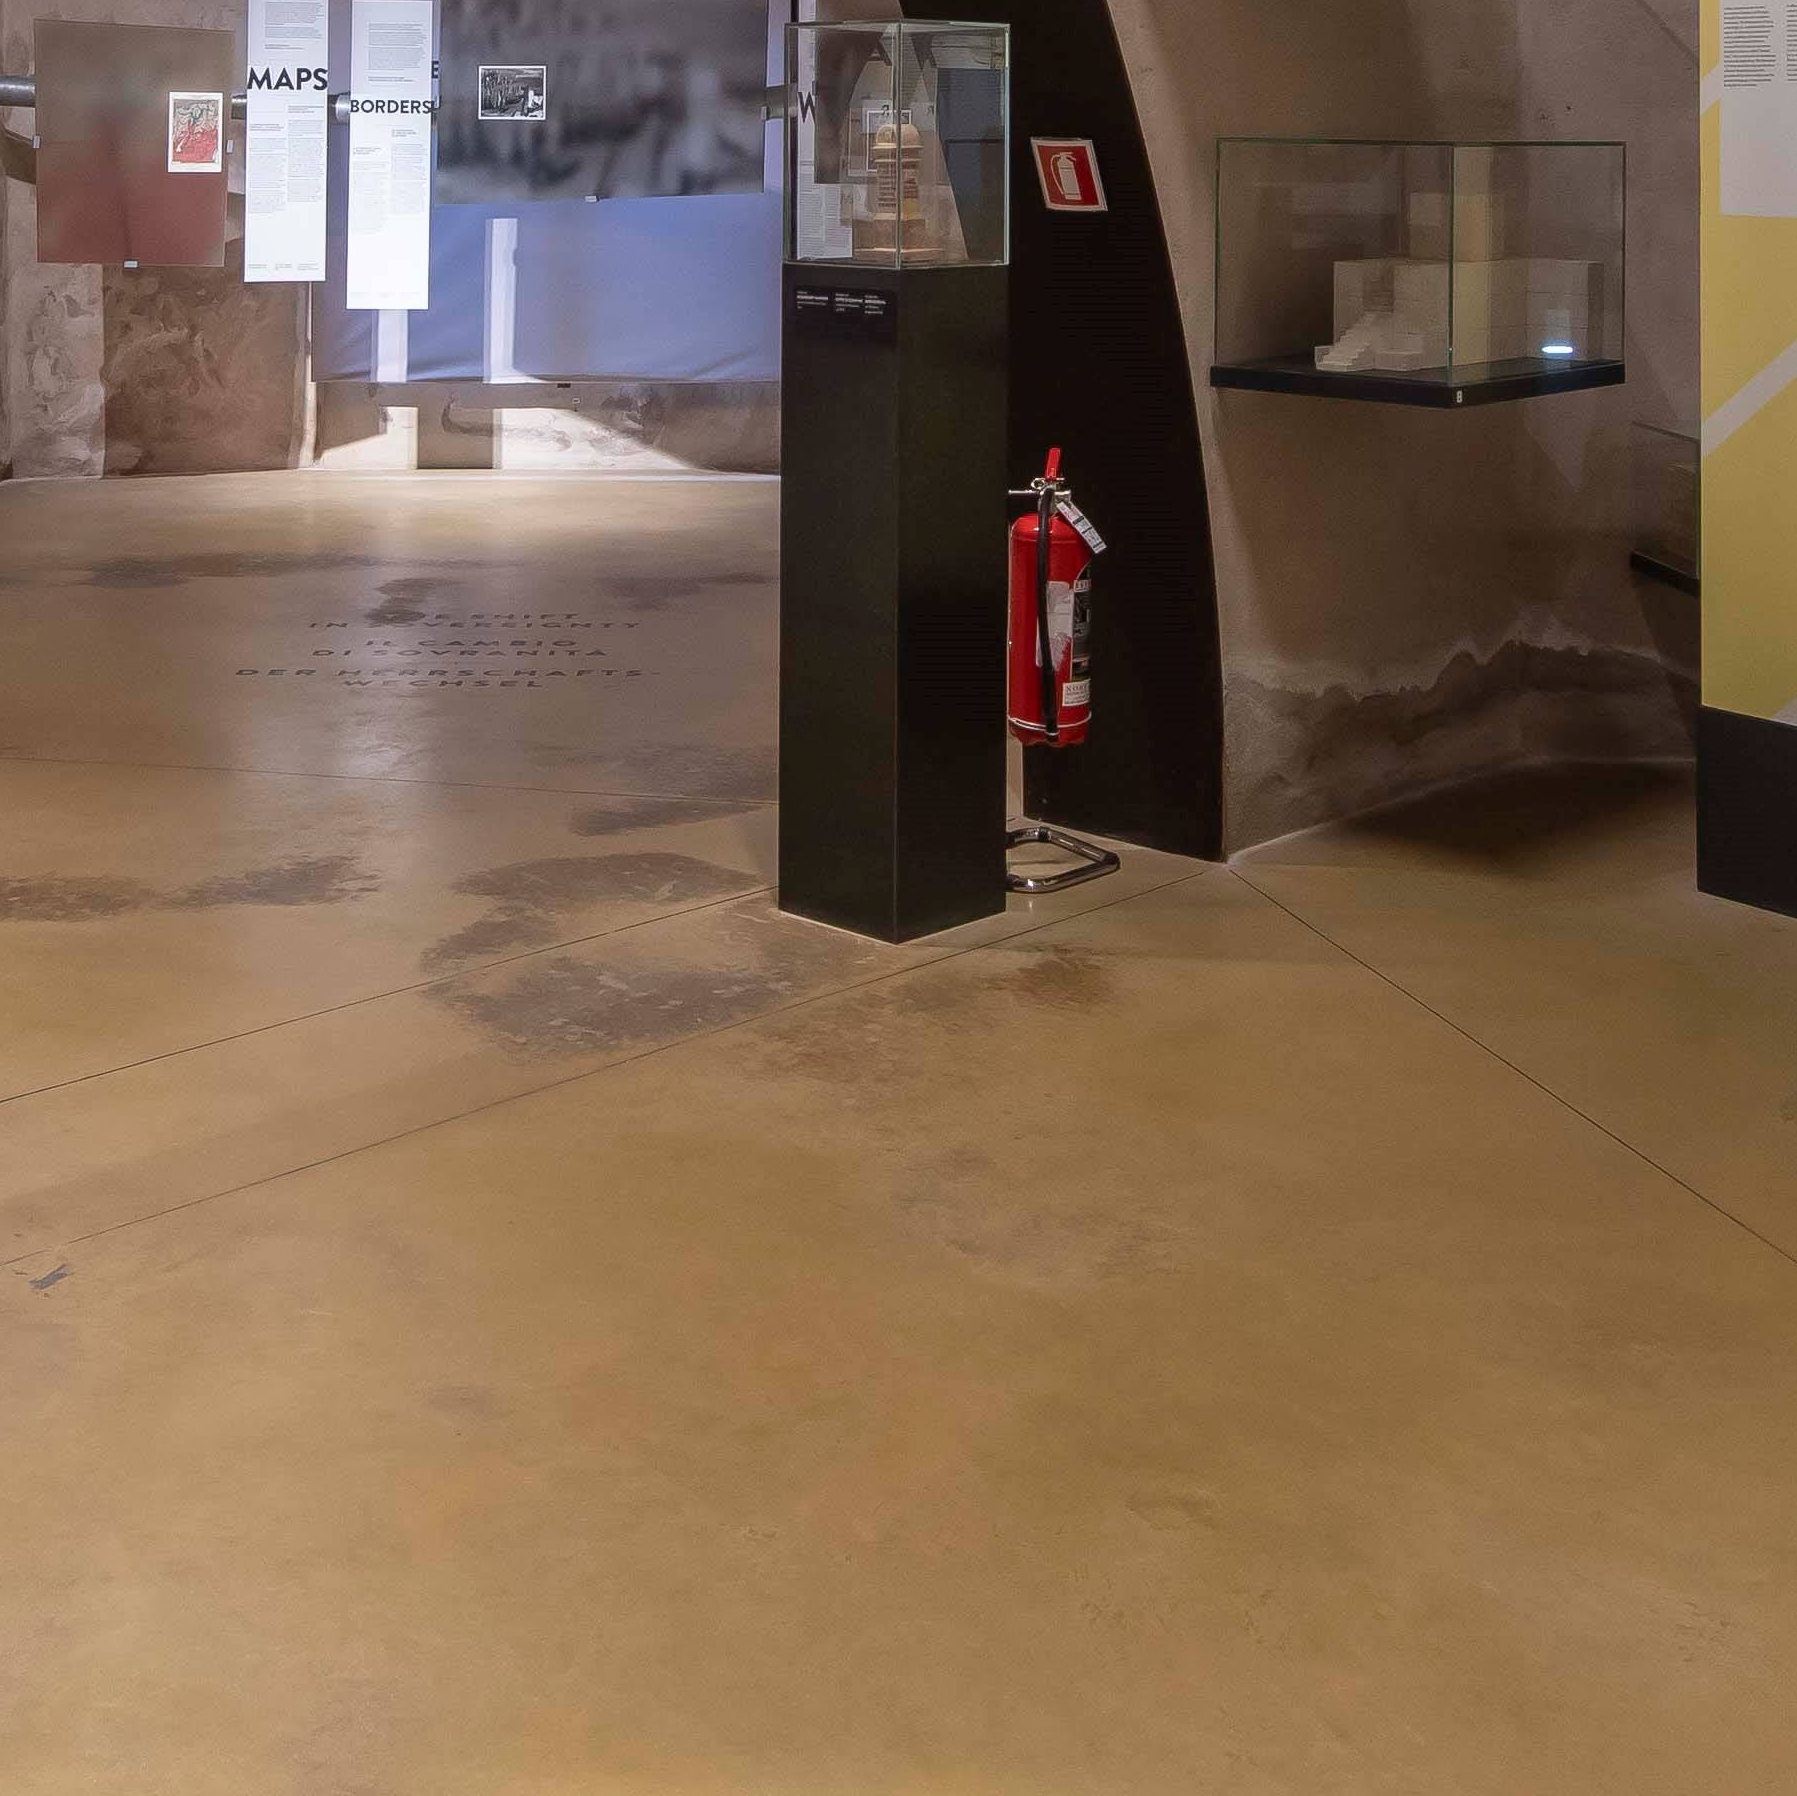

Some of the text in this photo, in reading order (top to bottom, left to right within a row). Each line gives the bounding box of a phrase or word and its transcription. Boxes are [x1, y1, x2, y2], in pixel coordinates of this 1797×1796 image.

[246, 67, 328, 91] MAPS
[350, 100, 432, 115] BORDERS
[235, 669, 318, 677] DER
